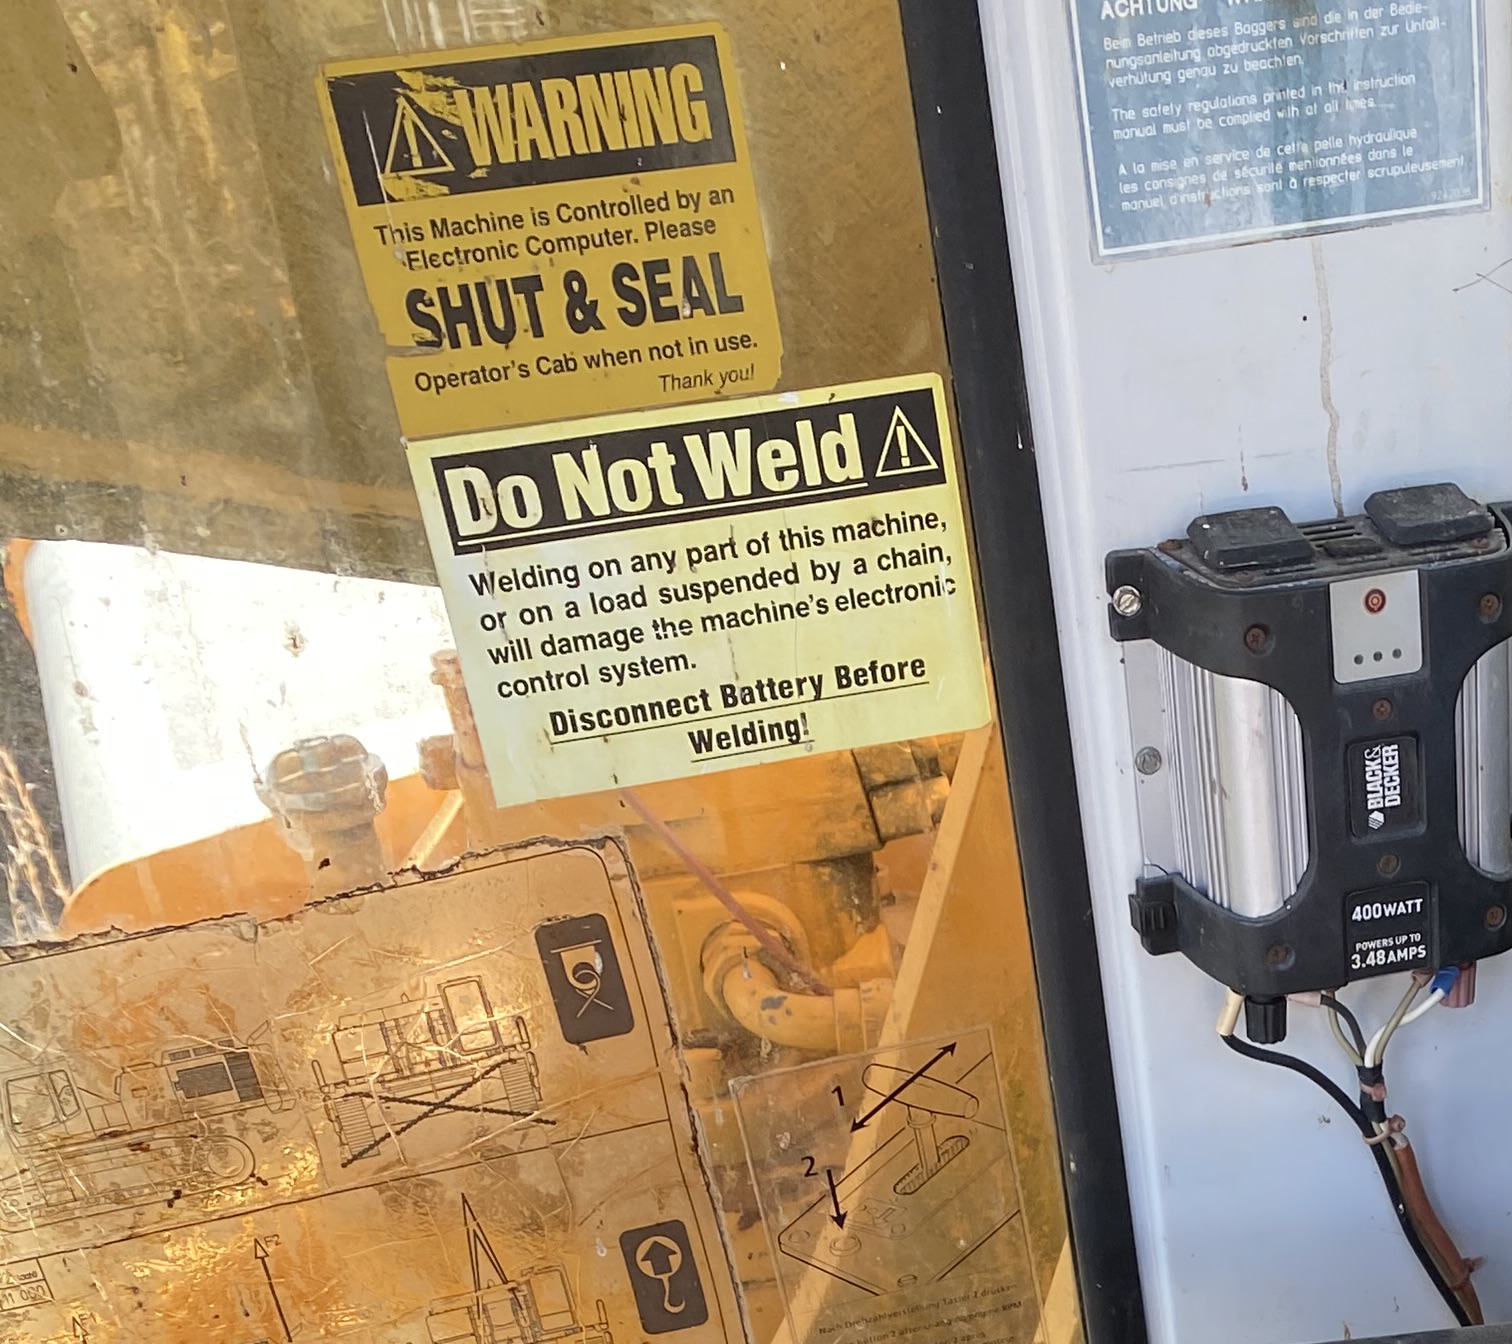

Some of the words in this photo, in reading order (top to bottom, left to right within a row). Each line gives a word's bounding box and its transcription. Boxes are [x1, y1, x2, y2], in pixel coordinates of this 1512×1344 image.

[1137, 30, 1181, 47] Betrieb
[1234, 19, 1286, 36] Baggers
[1207, 36, 1293, 58] abgedruckten
[1380, 23, 1399, 36] zur
[1178, 65, 1216, 83] genau
[1223, 63, 1238, 75] zu
[453, 63, 712, 167] WARNING
[1111, 107, 1136, 122] The
[1142, 102, 1181, 118] safety
[1188, 93, 1257, 114] regulations
[1263, 85, 1305, 104] printed
[1353, 73, 1416, 91] instruction
[1113, 124, 1156, 140] manual
[1162, 121, 1190, 134] must
[1218, 109, 1271, 127] complied
[1276, 104, 1299, 119] with
[1305, 102, 1317, 115] at
[1324, 99, 1339, 113] all
[1119, 182, 1138, 194] les
[1144, 174, 1206, 191] consignes
[1212, 170, 1227, 182] de
[1367, 148, 1397, 162] dans
[1402, 144, 1413, 157] le
[1133, 161, 1145, 174] la
[1151, 158, 1177, 172] mise
[1183, 156, 1199, 168] en
[1205, 148, 1249, 165] service
[1314, 135, 1343, 151] pelle
[1349, 127, 1417, 148] hydraulique
[1121, 195, 1164, 212] manuel
[1303, 169, 1360, 187] respecter
[374, 221, 425, 246] This
[429, 211, 524, 239] Machine
[530, 206, 551, 227] is
[556, 191, 671, 223] Controlled
[676, 189, 701, 213] by
[708, 187, 735, 206] an
[405, 239, 519, 271] Electronic
[525, 228, 639, 256] Computer.
[645, 218, 717, 242] Please
[405, 274, 544, 349] SHUT
[563, 269, 606, 334] &
[612, 252, 744, 328] SEAL
[536, 352, 578, 376] Cab
[583, 348, 643, 370] when
[648, 341, 684, 362] not
[688, 335, 709, 356] in
[715, 333, 758, 353] use.
[659, 370, 714, 392] Thank
[718, 363, 756, 387] you!
[444, 466, 543, 537] Do
[552, 441, 684, 521] Not
[682, 412, 864, 501] Weld
[469, 563, 580, 596] Welding
[588, 558, 622, 579] on
[631, 549, 676, 574] any
[686, 537, 739, 569] part
[746, 531, 771, 556] of
[779, 526, 825, 552] this
[832, 511, 947, 543] machine,
[480, 610, 507, 632] or
[519, 604, 554, 626] on
[565, 600, 581, 618] a
[589, 585, 648, 615] load
[658, 561, 800, 604] suspended
[810, 559, 841, 584] by
[853, 557, 867, 576] a
[877, 542, 952, 571] chain,
[487, 637, 533, 665] will
[540, 625, 645, 658] damage
[651, 617, 694, 640] the
[835, 574, 957, 612] electronic
[497, 663, 590, 698] control
[599, 653, 697, 686] system.
[549, 688, 713, 737] Disconnect
[720, 672, 824, 709] Battery
[834, 657, 928, 690] Before
[688, 712, 810, 756] Welding!
[1382, 744, 1401, 807] DECKER
[1355, 937, 1394, 952] POWERS
[1395, 934, 1408, 945] UP
[1409, 932, 1421, 943] TO
[831, 1085, 845, 1106] 1
[801, 1155, 818, 1178] 2
[264, 1234, 281, 1251] F2
